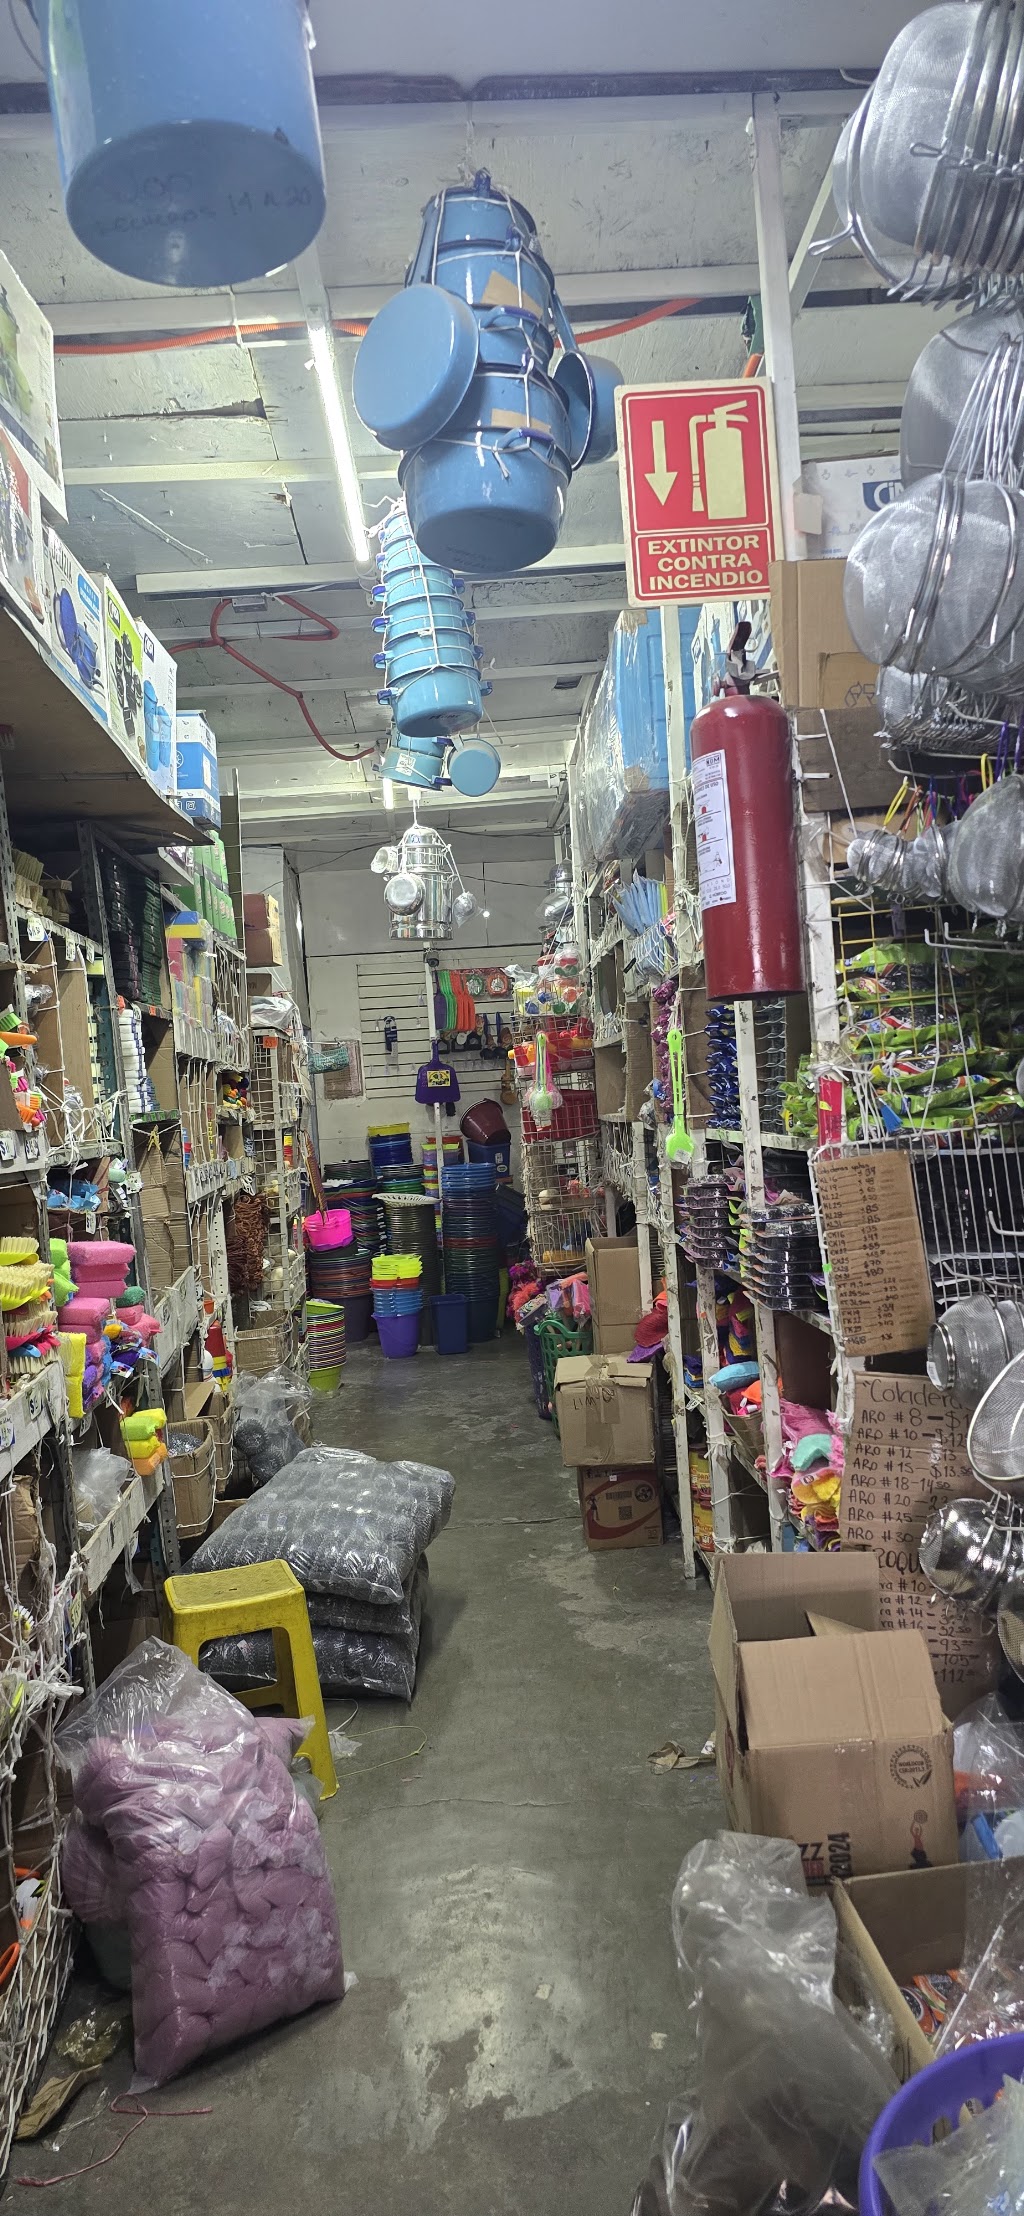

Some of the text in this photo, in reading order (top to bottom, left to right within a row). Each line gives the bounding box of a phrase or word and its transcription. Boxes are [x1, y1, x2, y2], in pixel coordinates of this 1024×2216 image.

[648, 534, 760, 555] EXTINTOR
[657, 552, 752, 572] CONTRA
[649, 569, 763, 591] INCENDIO
[862, 1409, 886, 1424] ARO
[909, 1407, 923, 1427] 8
[857, 1427, 884, 1441] ARO
[903, 1428, 918, 1441] 10
[855, 1443, 881, 1456] ARO
[900, 1447, 912, 1459] 12
[853, 1457, 878, 1471] ARO
[898, 1461, 914, 1474] 15
[850, 1473, 877, 1488] ARO
[894, 1476, 910, 1491] 18
[848, 1488, 876, 1505] ARO
[894, 1493, 911, 1507] 20
[848, 1506, 874, 1521] ARO
[895, 1511, 913, 1523] 25
[847, 1526, 874, 1541] ARO
[895, 1530, 913, 1543] 30
[911, 1580, 926, 1592] 10
[908, 1595, 922, 1605] 12
[909, 1608, 923, 1618] 14
[827, 1832, 853, 1877] 2024
